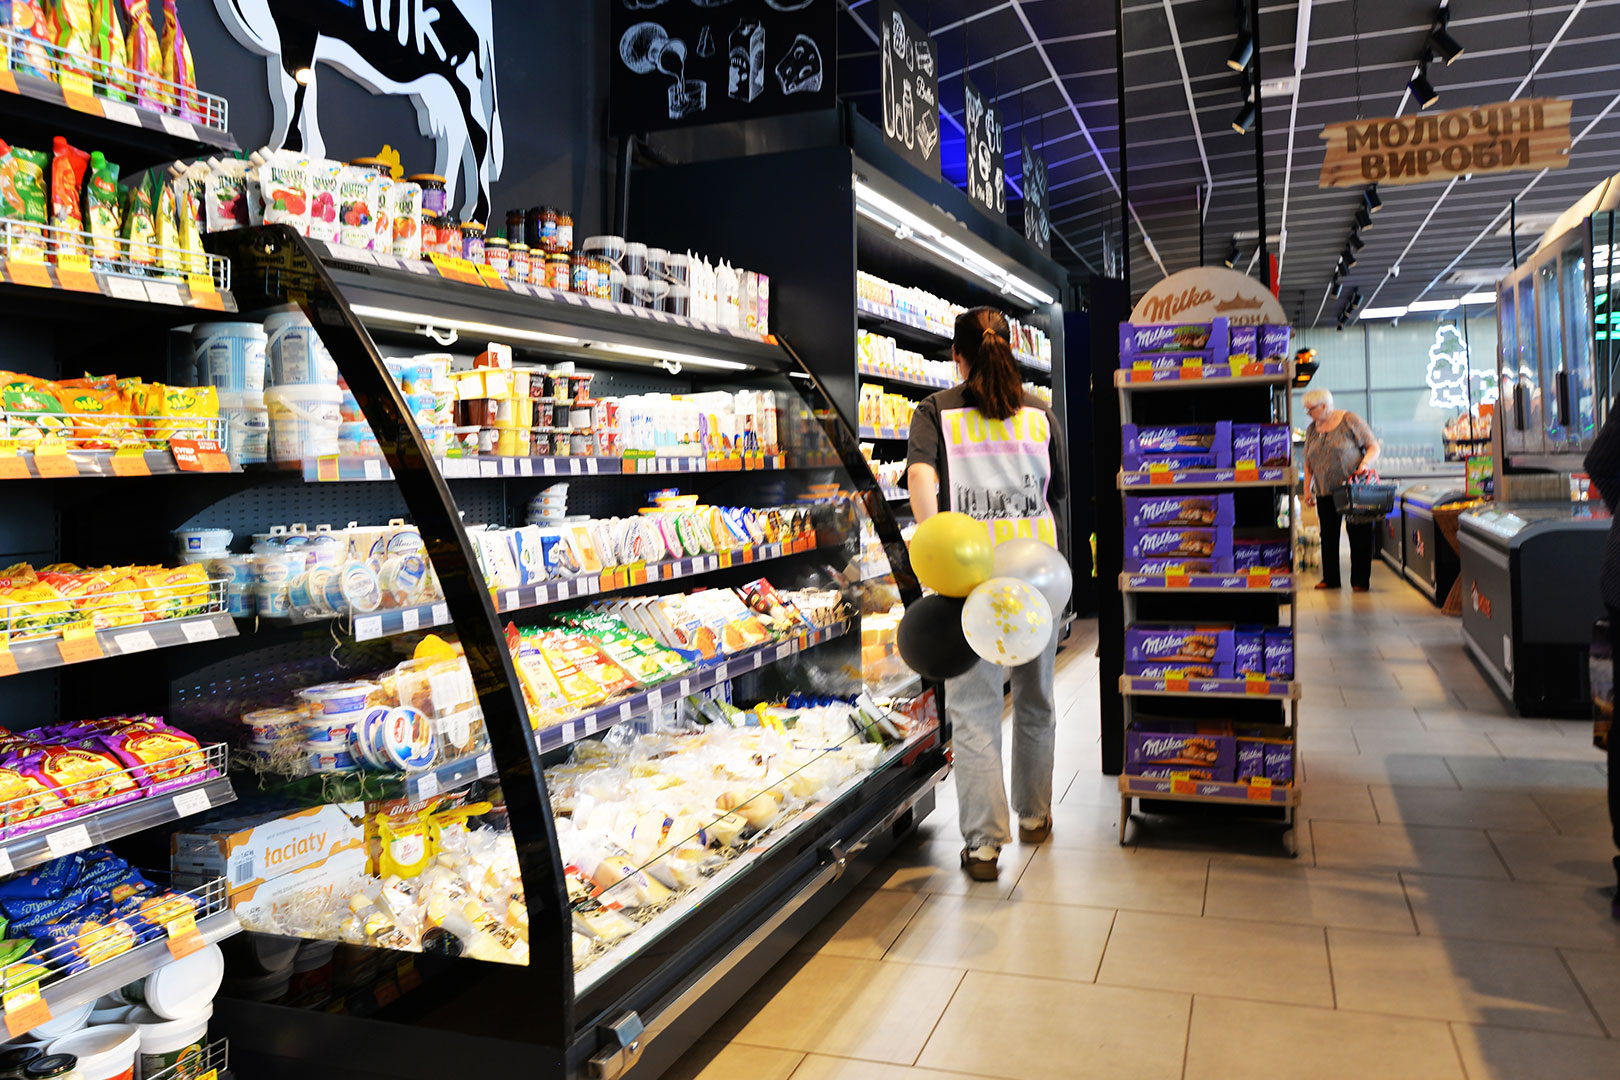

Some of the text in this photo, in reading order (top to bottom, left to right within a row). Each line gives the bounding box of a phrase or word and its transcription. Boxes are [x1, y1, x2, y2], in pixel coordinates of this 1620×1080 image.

[363, 0, 447, 62] ilk
[1346, 104, 1544, 153] МОЛОЧНІ
[1361, 137, 1530, 180] ВИРОБИ
[1143, 286, 1215, 322] Milka
[1135, 326, 1175, 347] Milka
[945, 408, 1047, 445] TOKYO
[1138, 427, 1178, 447] Milka
[1140, 499, 1181, 521] Milka
[1140, 530, 1181, 551] Milka
[1142, 634, 1182, 656] Milka
[1236, 643, 1263, 656] Milka
[1265, 645, 1293, 658] Milka
[1142, 736, 1183, 757] Milka
[264, 831, 326, 868] łaciaty
